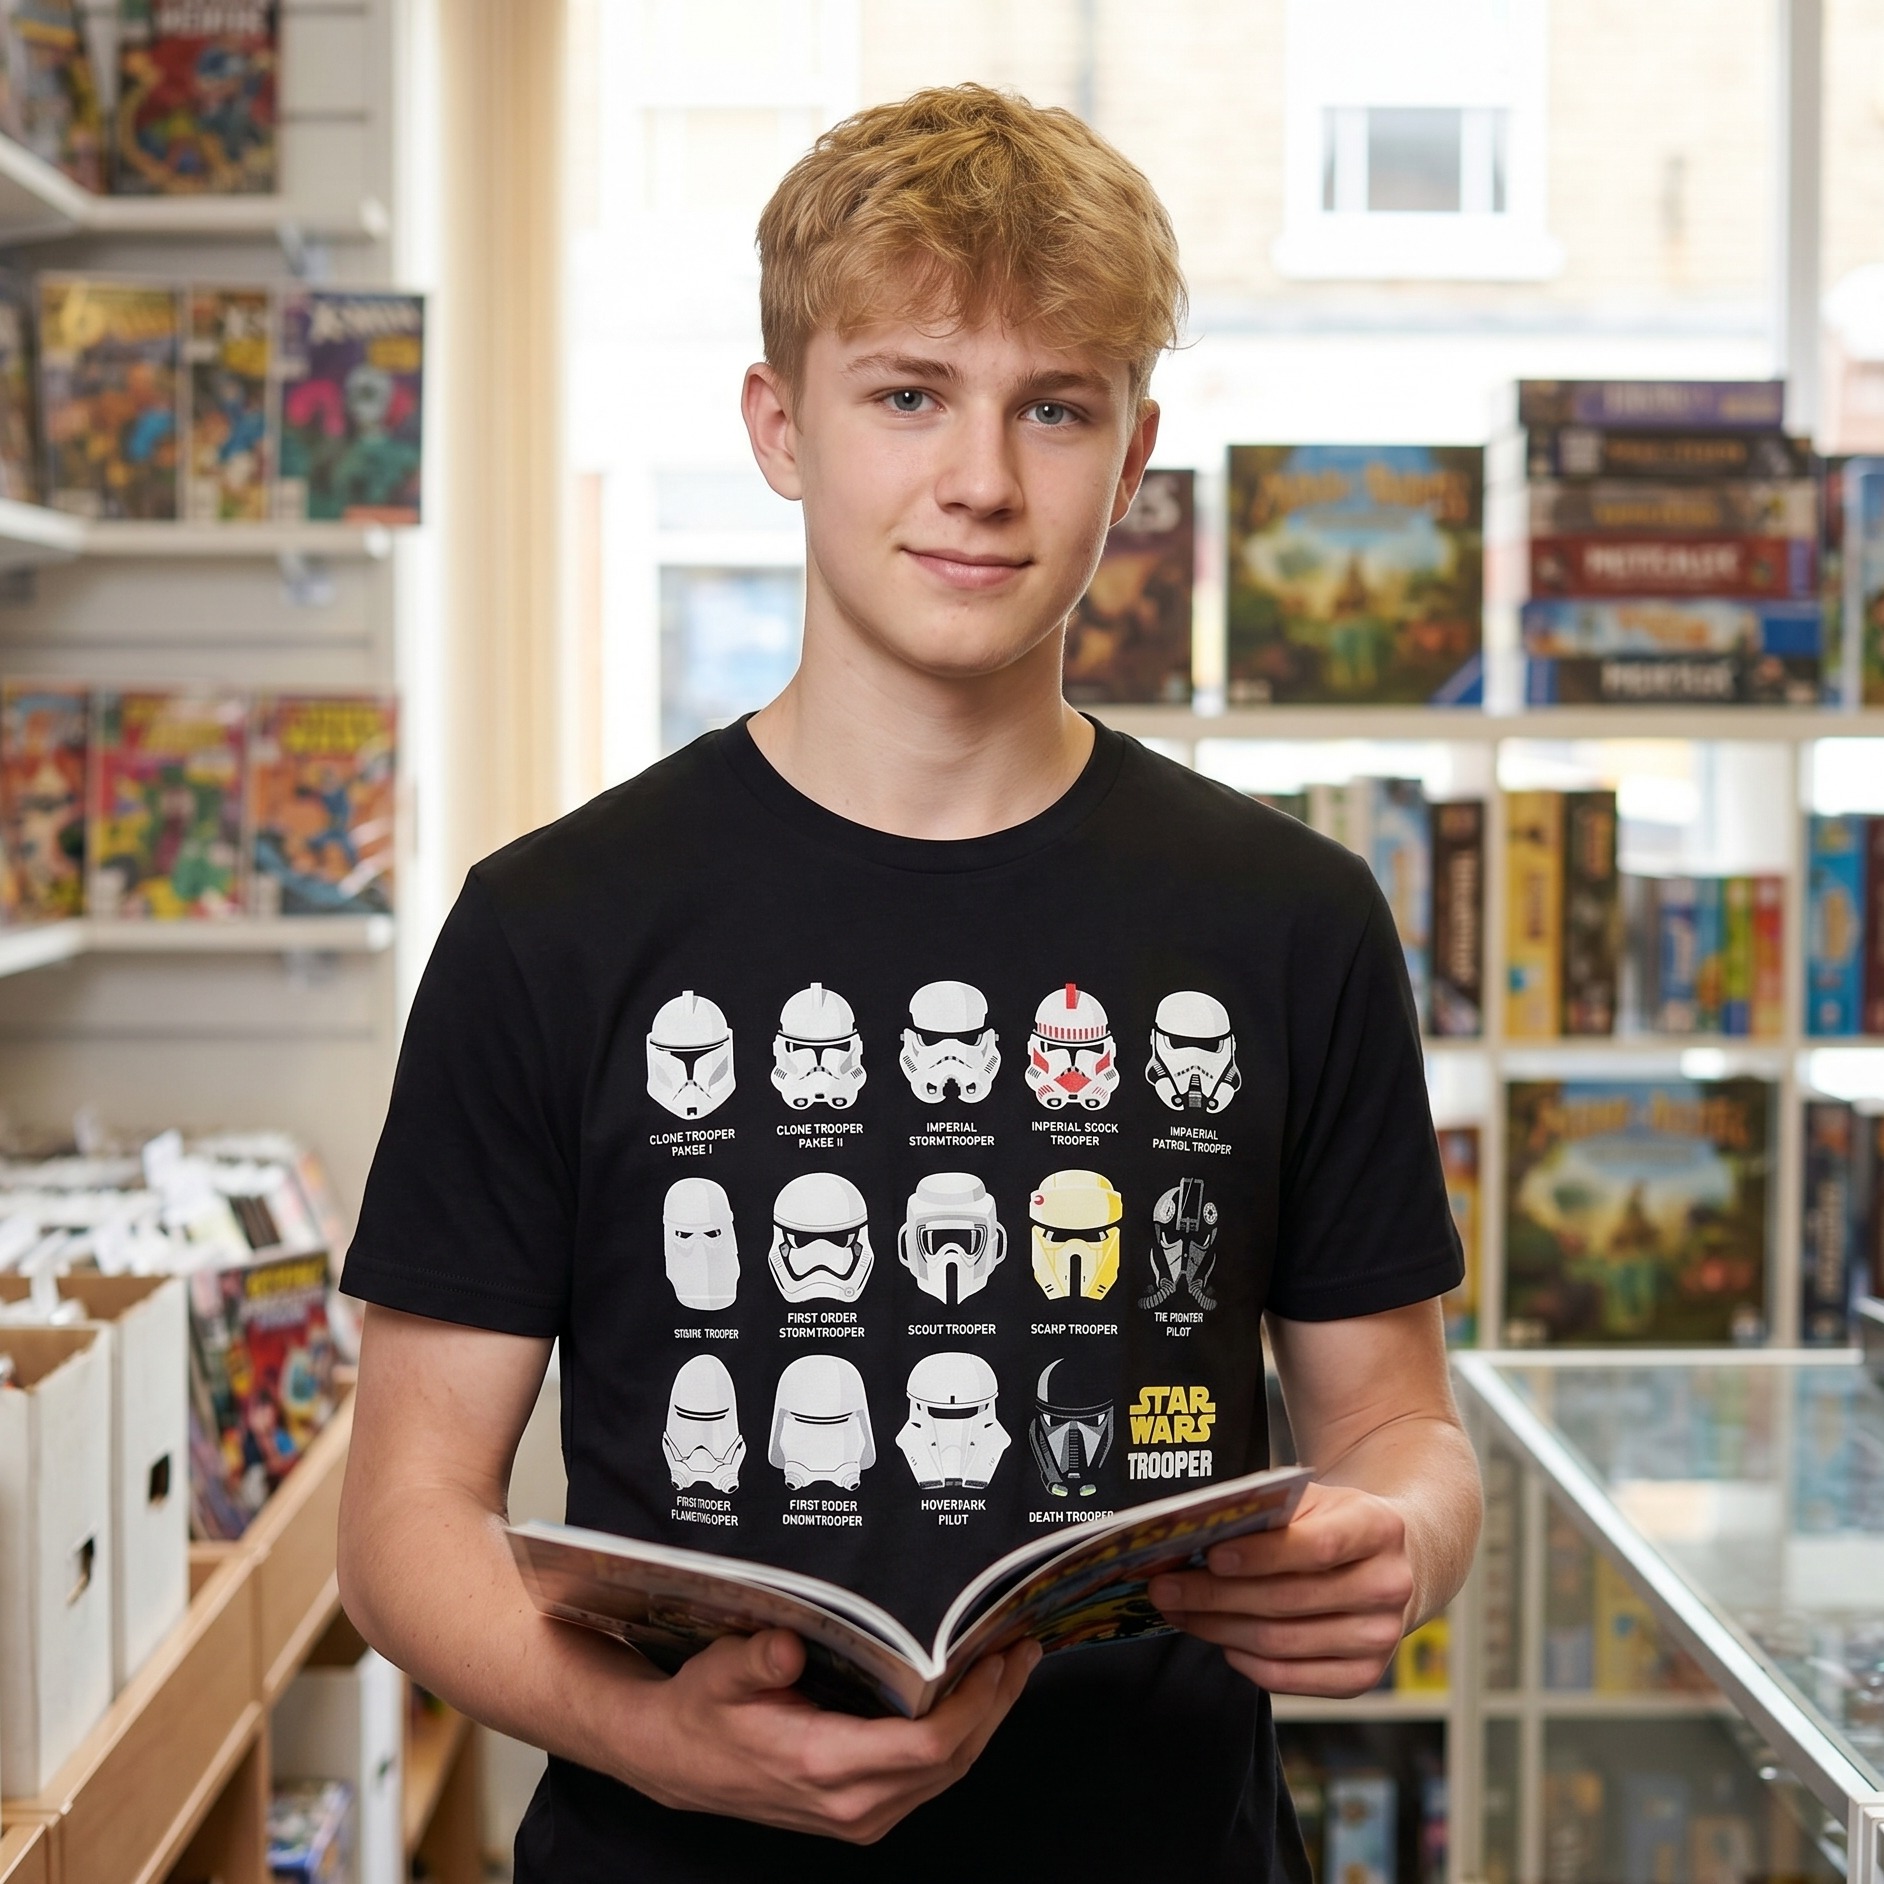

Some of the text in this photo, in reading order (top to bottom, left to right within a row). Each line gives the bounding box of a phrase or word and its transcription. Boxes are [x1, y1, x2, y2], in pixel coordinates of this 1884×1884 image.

[777, 1124, 863, 1135] CLONE TROOPER
[927, 1122, 977, 1132] IMPERIAL
[1032, 1122, 1081, 1131] INPERIAL
[650, 1129, 735, 1145] CLONE TROOPER
[909, 1136, 994, 1146] STORMTROOPER
[1051, 1135, 1099, 1145] TROOPER
[1192, 1142, 1231, 1154] TROOPER
[788, 1313, 857, 1323] FIRST ORDER
[704, 1329, 739, 1339] TROOPER
[779, 1327, 864, 1338] STORMTROOPER
[908, 1324, 996, 1335] SCOUT TROOPER
[1068, 1324, 1118, 1334] TROOPER
[1167, 1327, 1191, 1336] PILOT
[1129, 1386, 1216, 1415] STAR
[1129, 1414, 1216, 1445] WARS
[1128, 1450, 1212, 1479] TROOPER
[790, 1500, 819, 1510] FIRST
[1029, 1512, 1063, 1522] DEATH
